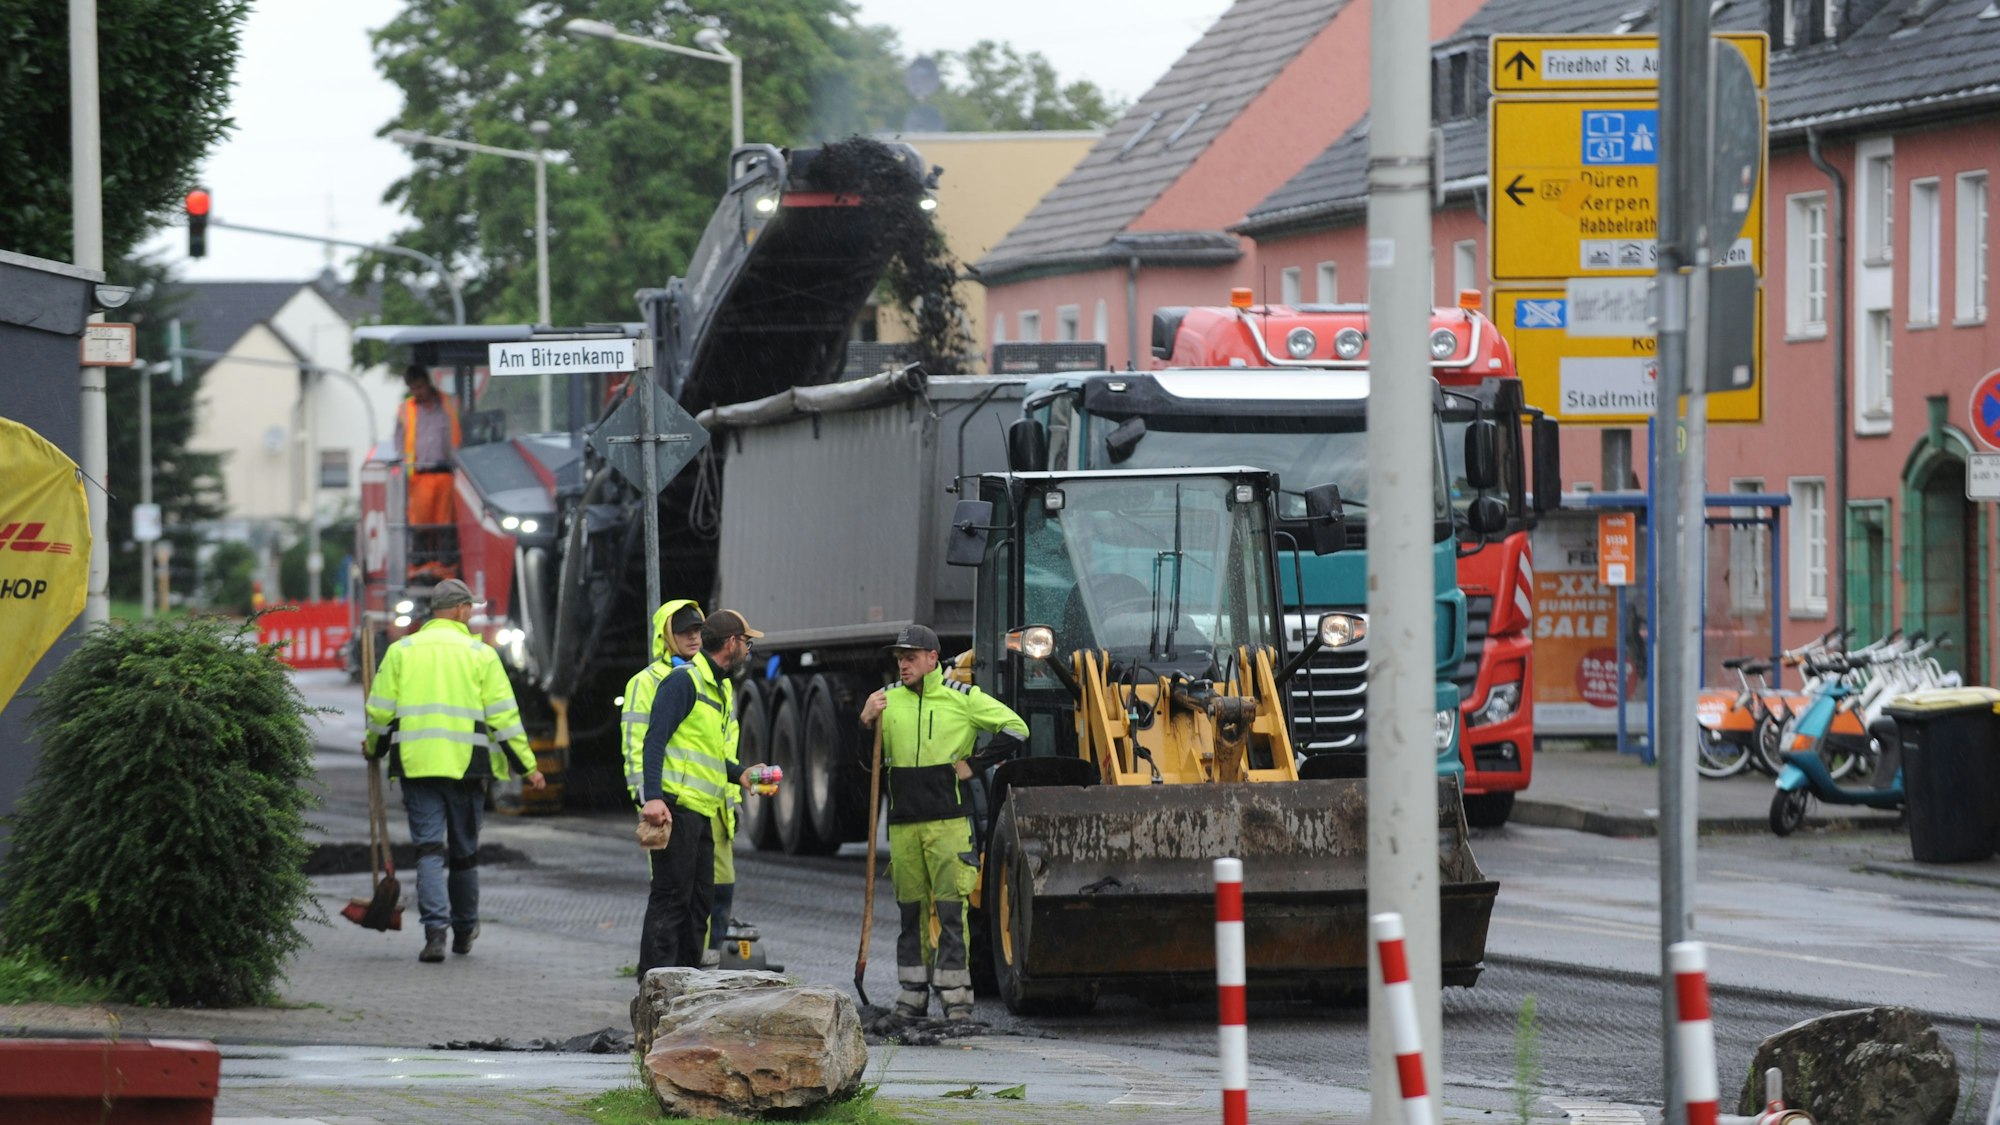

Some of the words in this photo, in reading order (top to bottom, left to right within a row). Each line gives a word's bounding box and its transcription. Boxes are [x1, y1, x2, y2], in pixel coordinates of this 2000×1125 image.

[1547, 55, 1608, 73] Friedhof
[1615, 57, 1635, 73] St.
[1643, 56, 1659, 72] Au
[1602, 115, 1610, 134] 1
[1597, 143, 1616, 159] 61
[1580, 170, 1639, 189] Düren
[1580, 193, 1651, 215] Kerpen
[1580, 216, 1658, 234] Habbelrath
[499, 349, 525, 368] Am
[531, 346, 625, 369] Bitzenkamp
[1567, 389, 1659, 408] Stadtmitt
[0, 578, 48, 600] HOP
[1537, 616, 1608, 638] SALE
